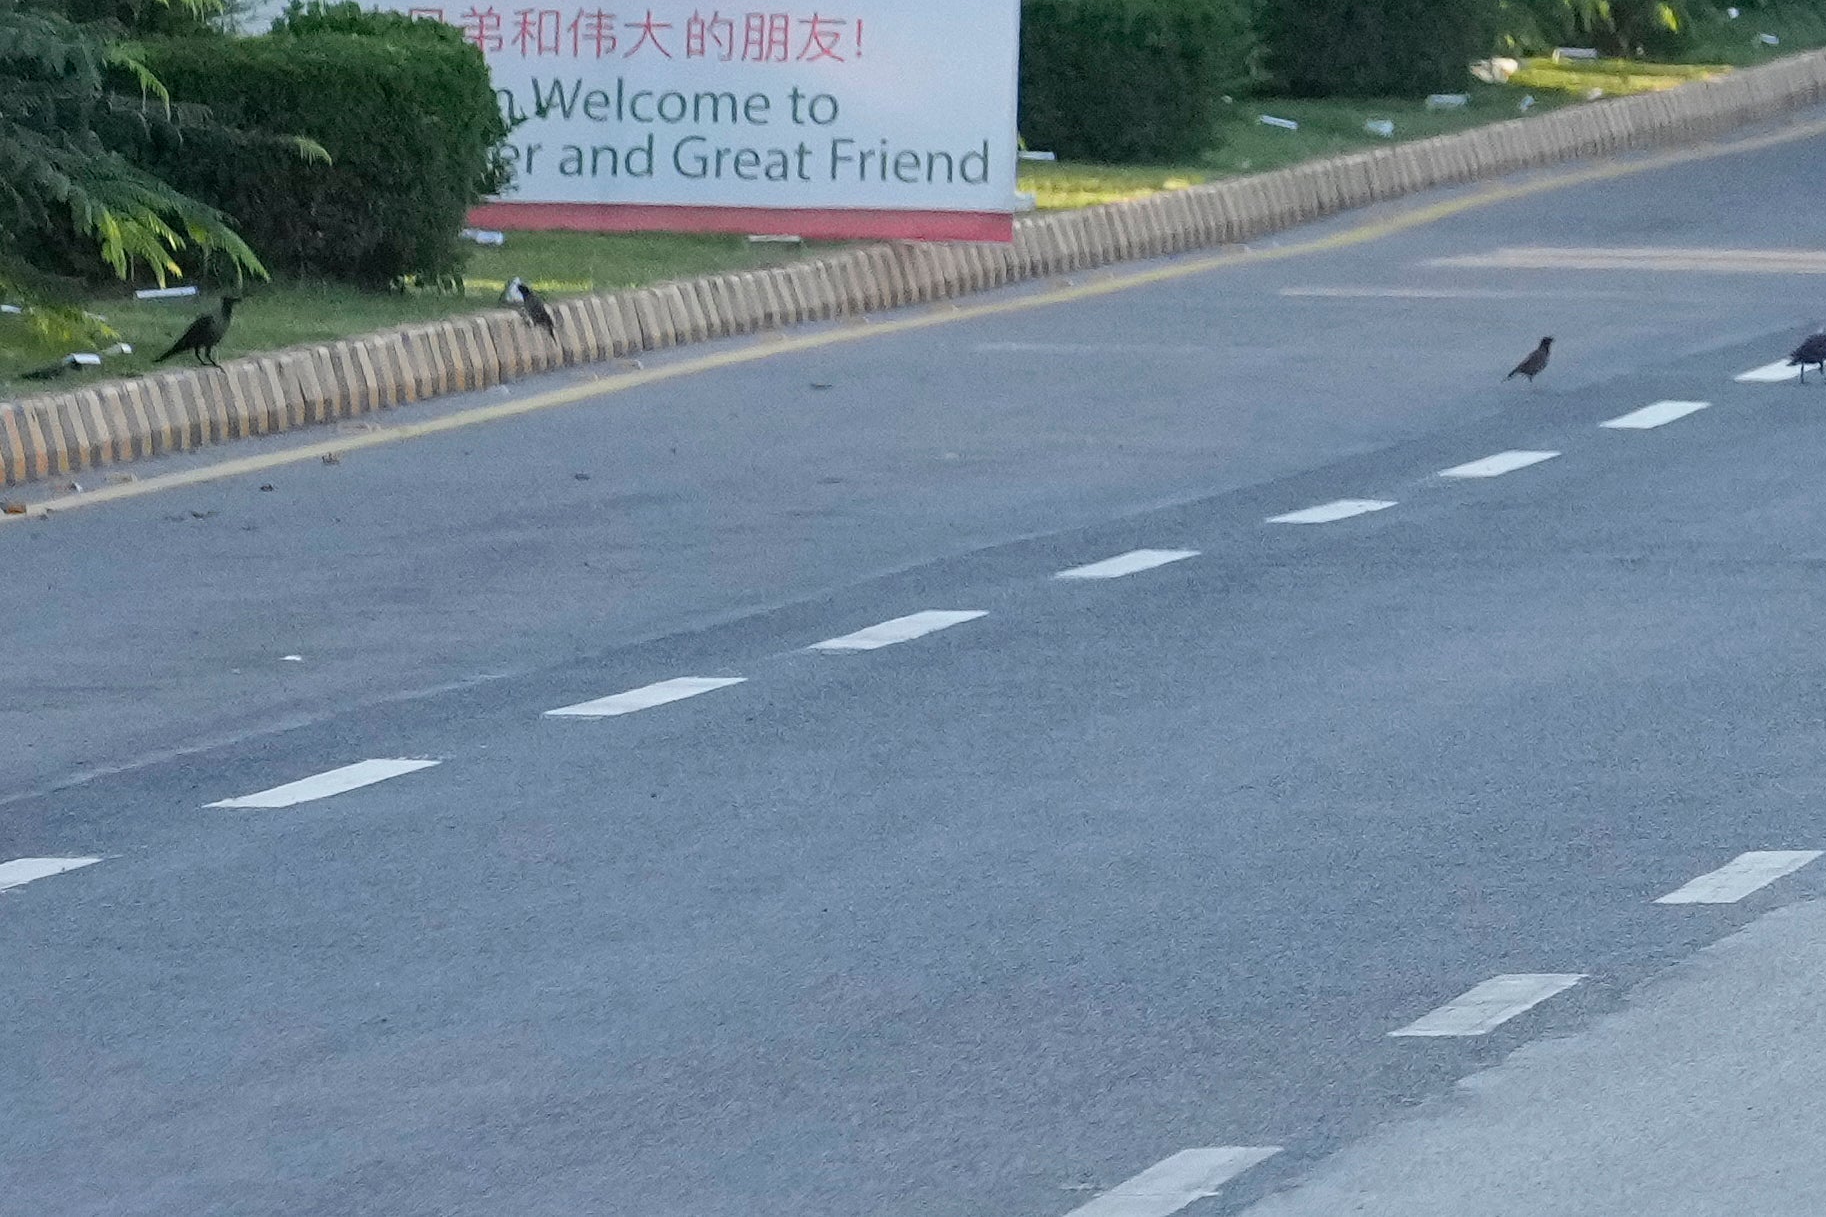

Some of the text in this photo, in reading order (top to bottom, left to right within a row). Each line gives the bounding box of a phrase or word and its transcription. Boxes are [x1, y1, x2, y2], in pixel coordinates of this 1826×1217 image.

[531, 76, 771, 125] Welcome
[787, 85, 840, 125] to
[558, 133, 653, 177] and
[672, 135, 812, 182] Great
[830, 138, 989, 184] Friend
